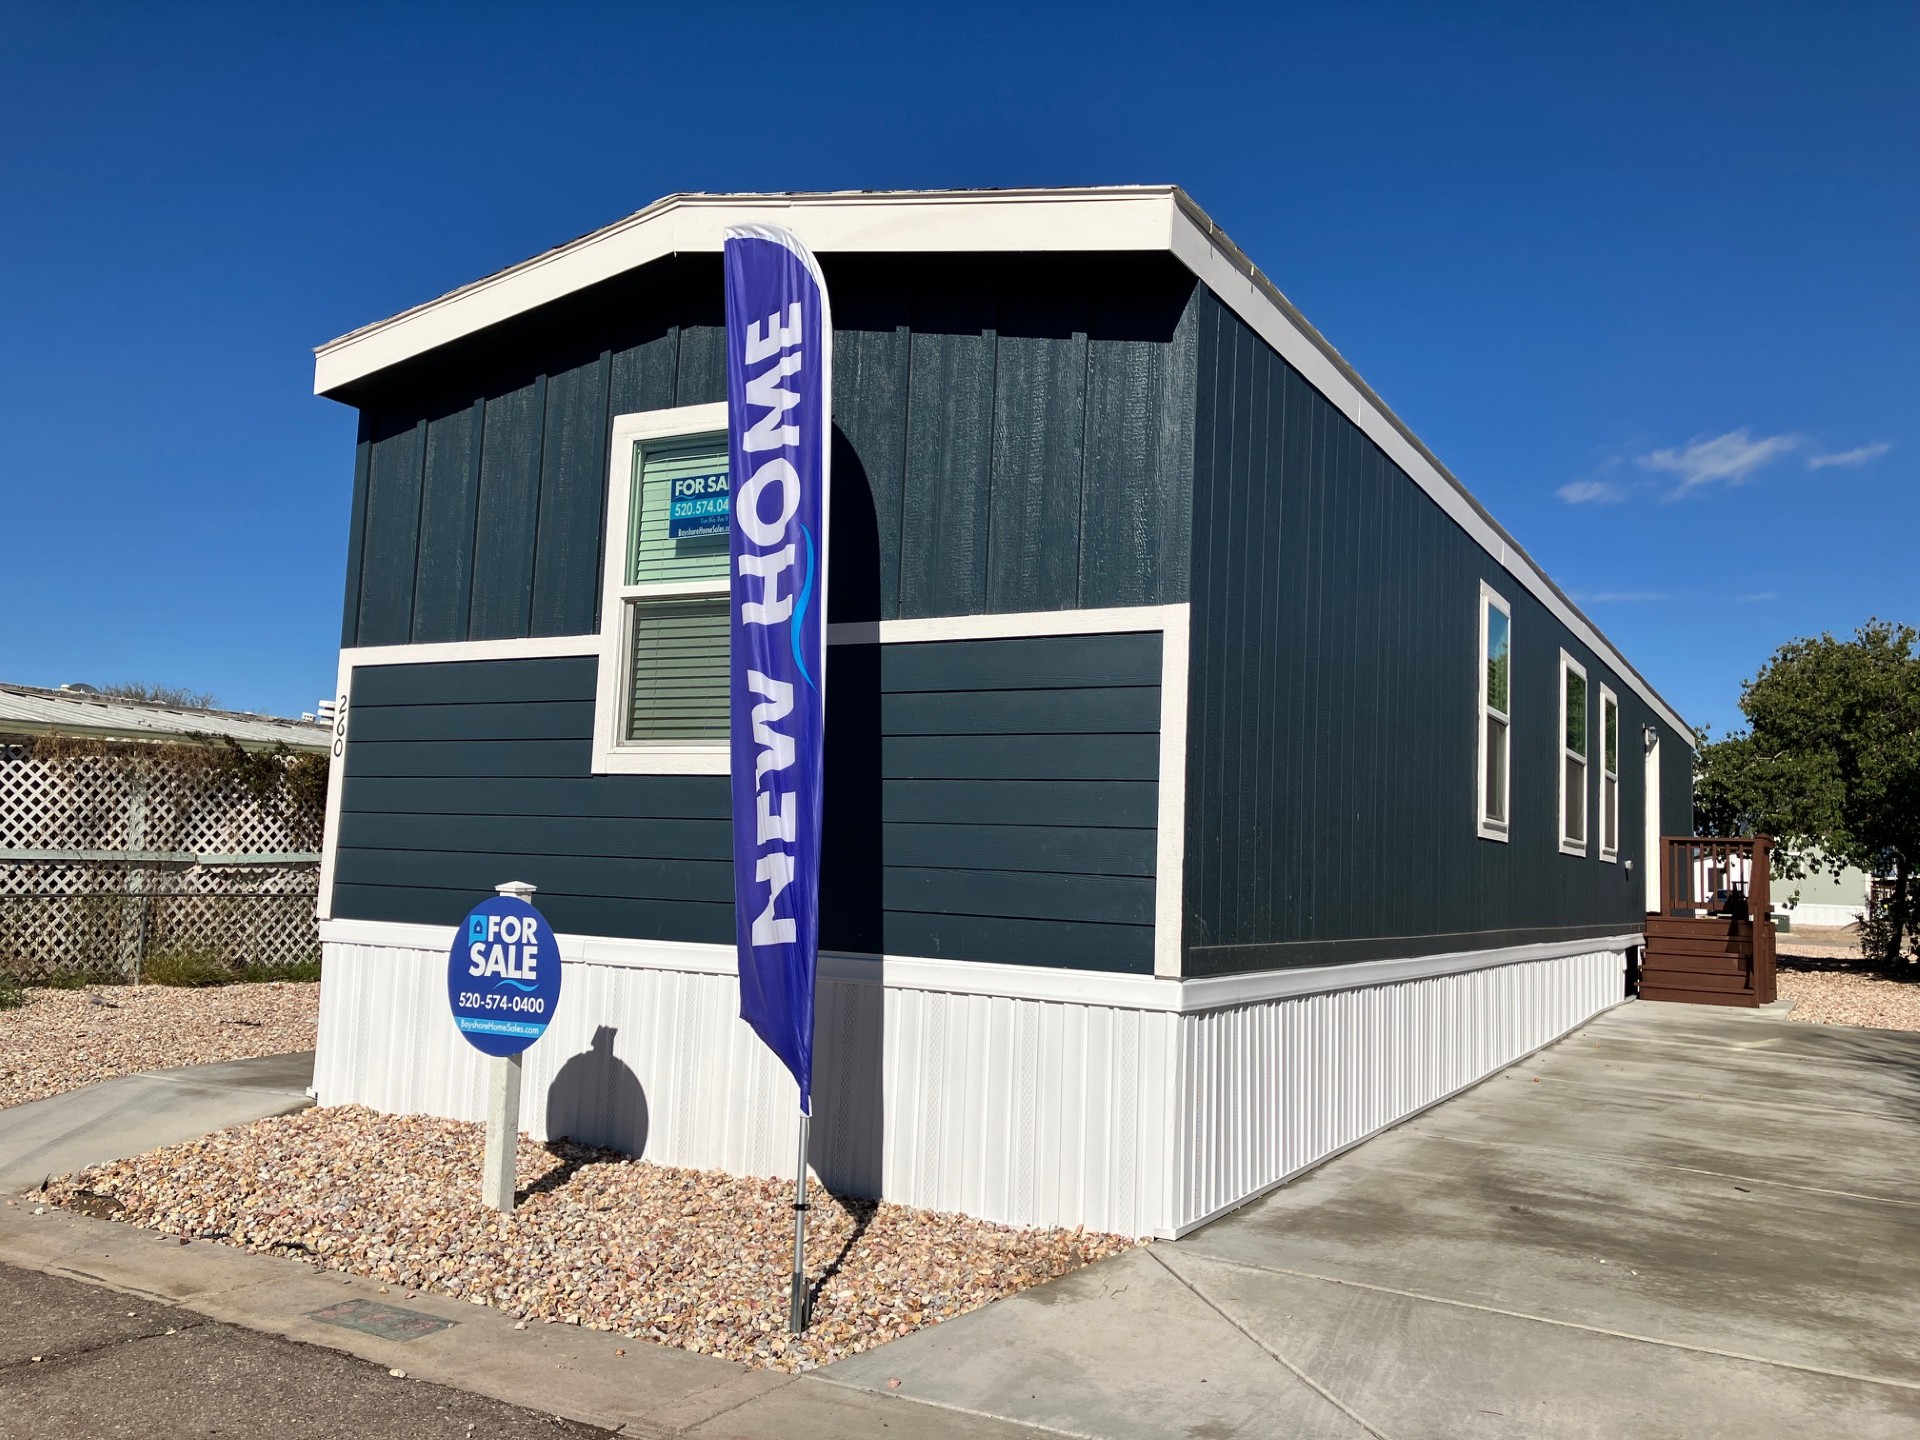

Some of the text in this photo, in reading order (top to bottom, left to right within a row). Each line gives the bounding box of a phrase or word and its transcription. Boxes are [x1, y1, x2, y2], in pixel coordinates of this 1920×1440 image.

[675, 475, 729, 496] FOR SA
[736, 301, 801, 946] NEW HOME
[333, 694, 348, 757] 260
[487, 915, 538, 944] FOR
[468, 942, 539, 980] SALE
[458, 991, 544, 1013] 520-574-0400
[460, 1019, 539, 1035] BayshoreHomeSales.com
